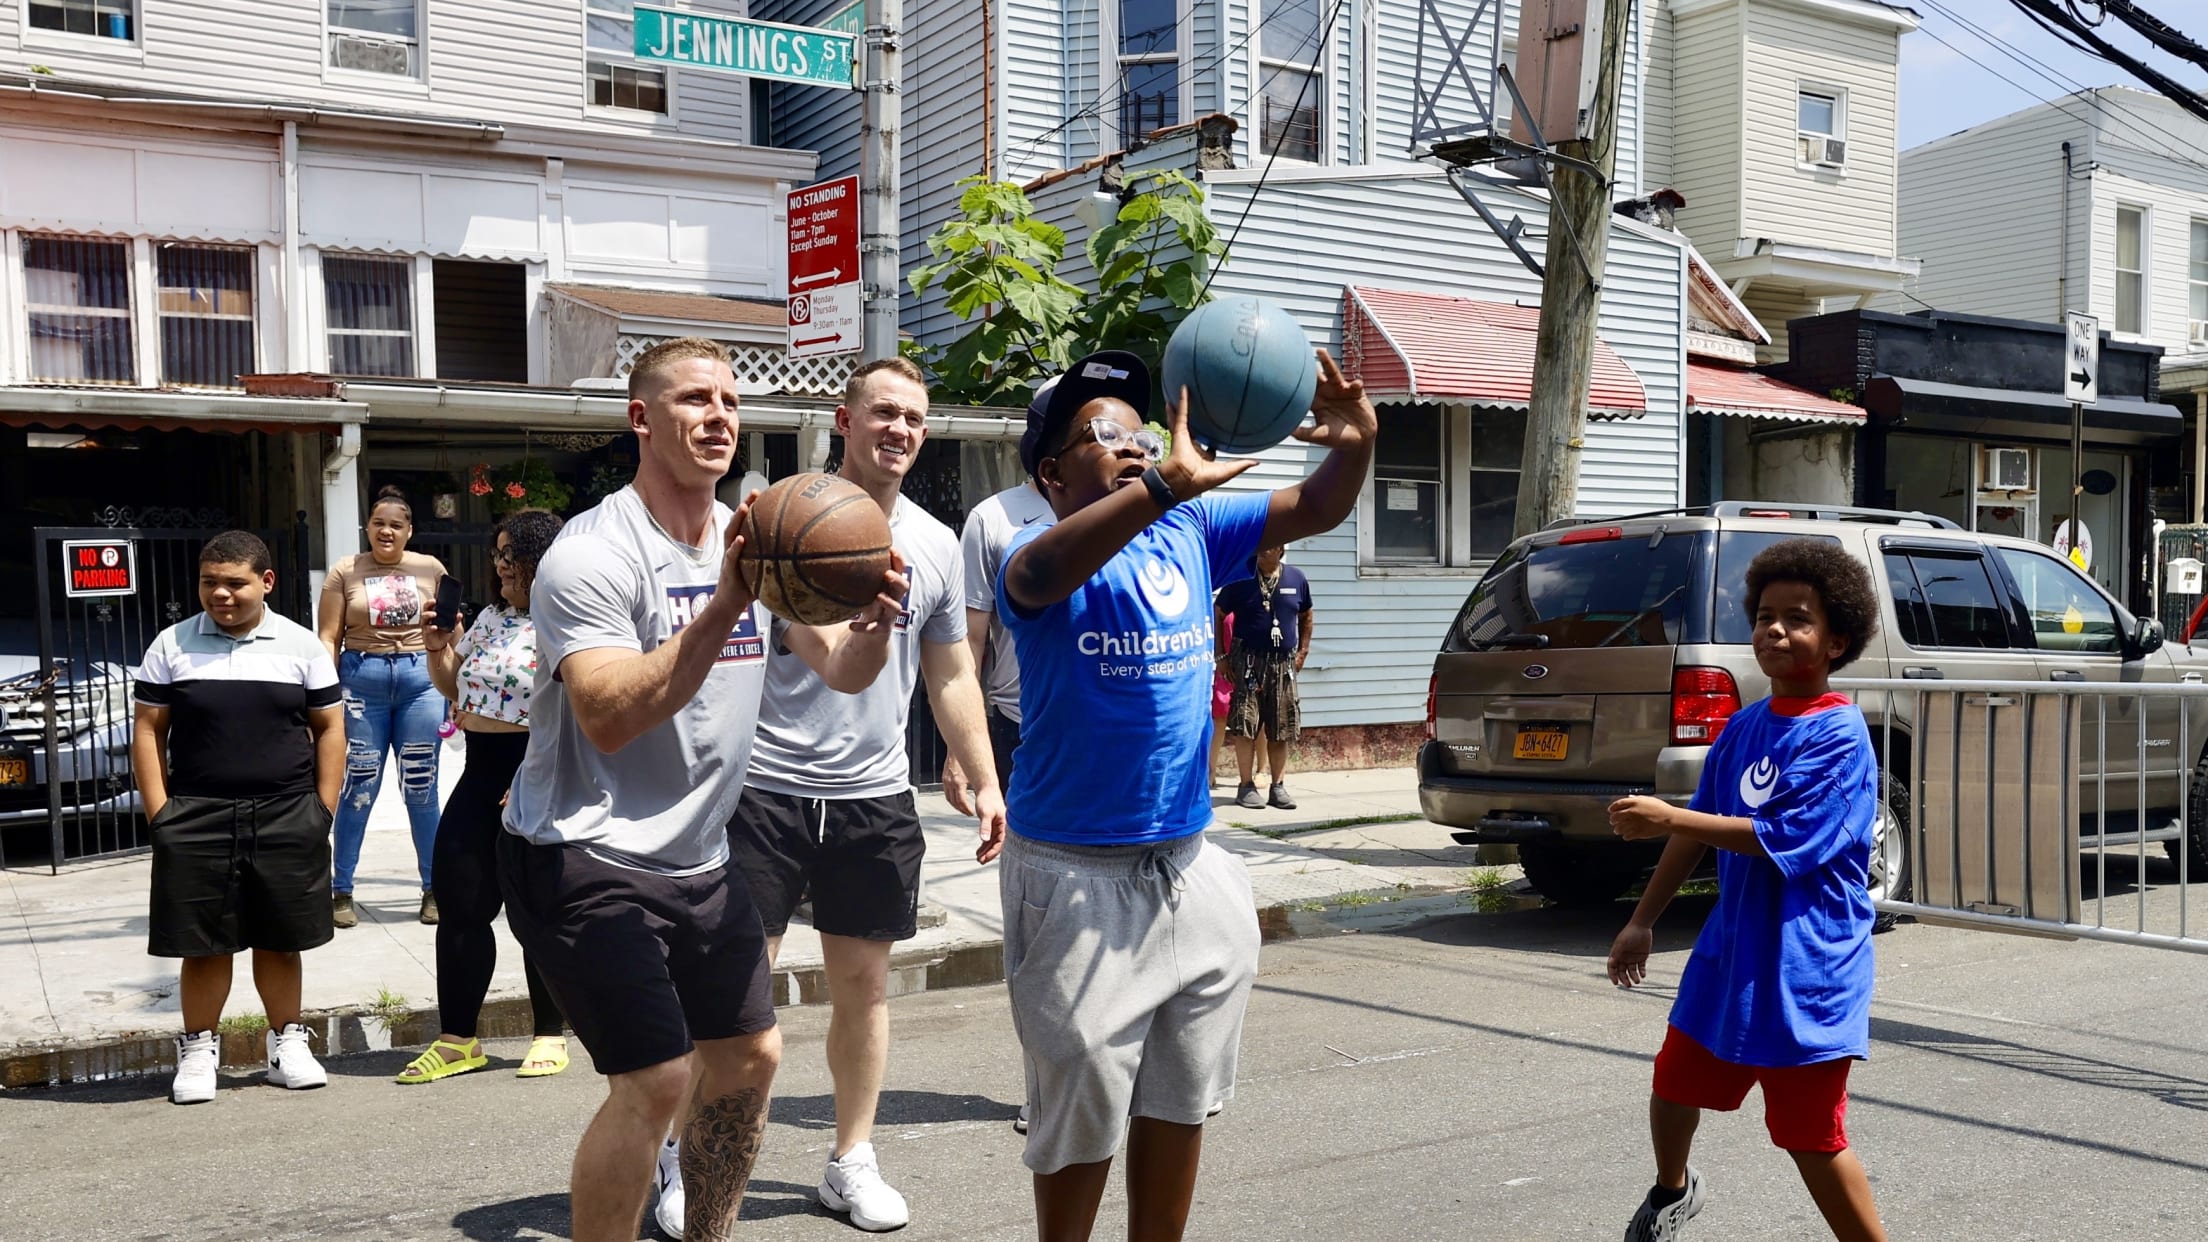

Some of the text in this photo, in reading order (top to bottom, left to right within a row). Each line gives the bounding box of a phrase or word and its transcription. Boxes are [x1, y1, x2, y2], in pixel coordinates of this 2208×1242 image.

[650, 12, 808, 76] JENNINGS
[823, 39, 852, 62] ST
[790, 184, 846, 211] NO STANDING
[790, 216, 806, 228] June
[812, 208, 839, 223] October
[811, 225, 825, 236] 7pm
[790, 234, 838, 253] Except Sunday
[2075, 320, 2090, 340] ONE
[2074, 343, 2090, 363] WAY
[79, 548, 97, 567] NO
[74, 568, 127, 589] PARKING
[744, 643, 761, 655] EXCEL
[1077, 623, 1204, 656] Children's
[1099, 662, 1143, 679] Every
[1147, 660, 1175, 676] step
[1177, 656, 1187, 671] of
